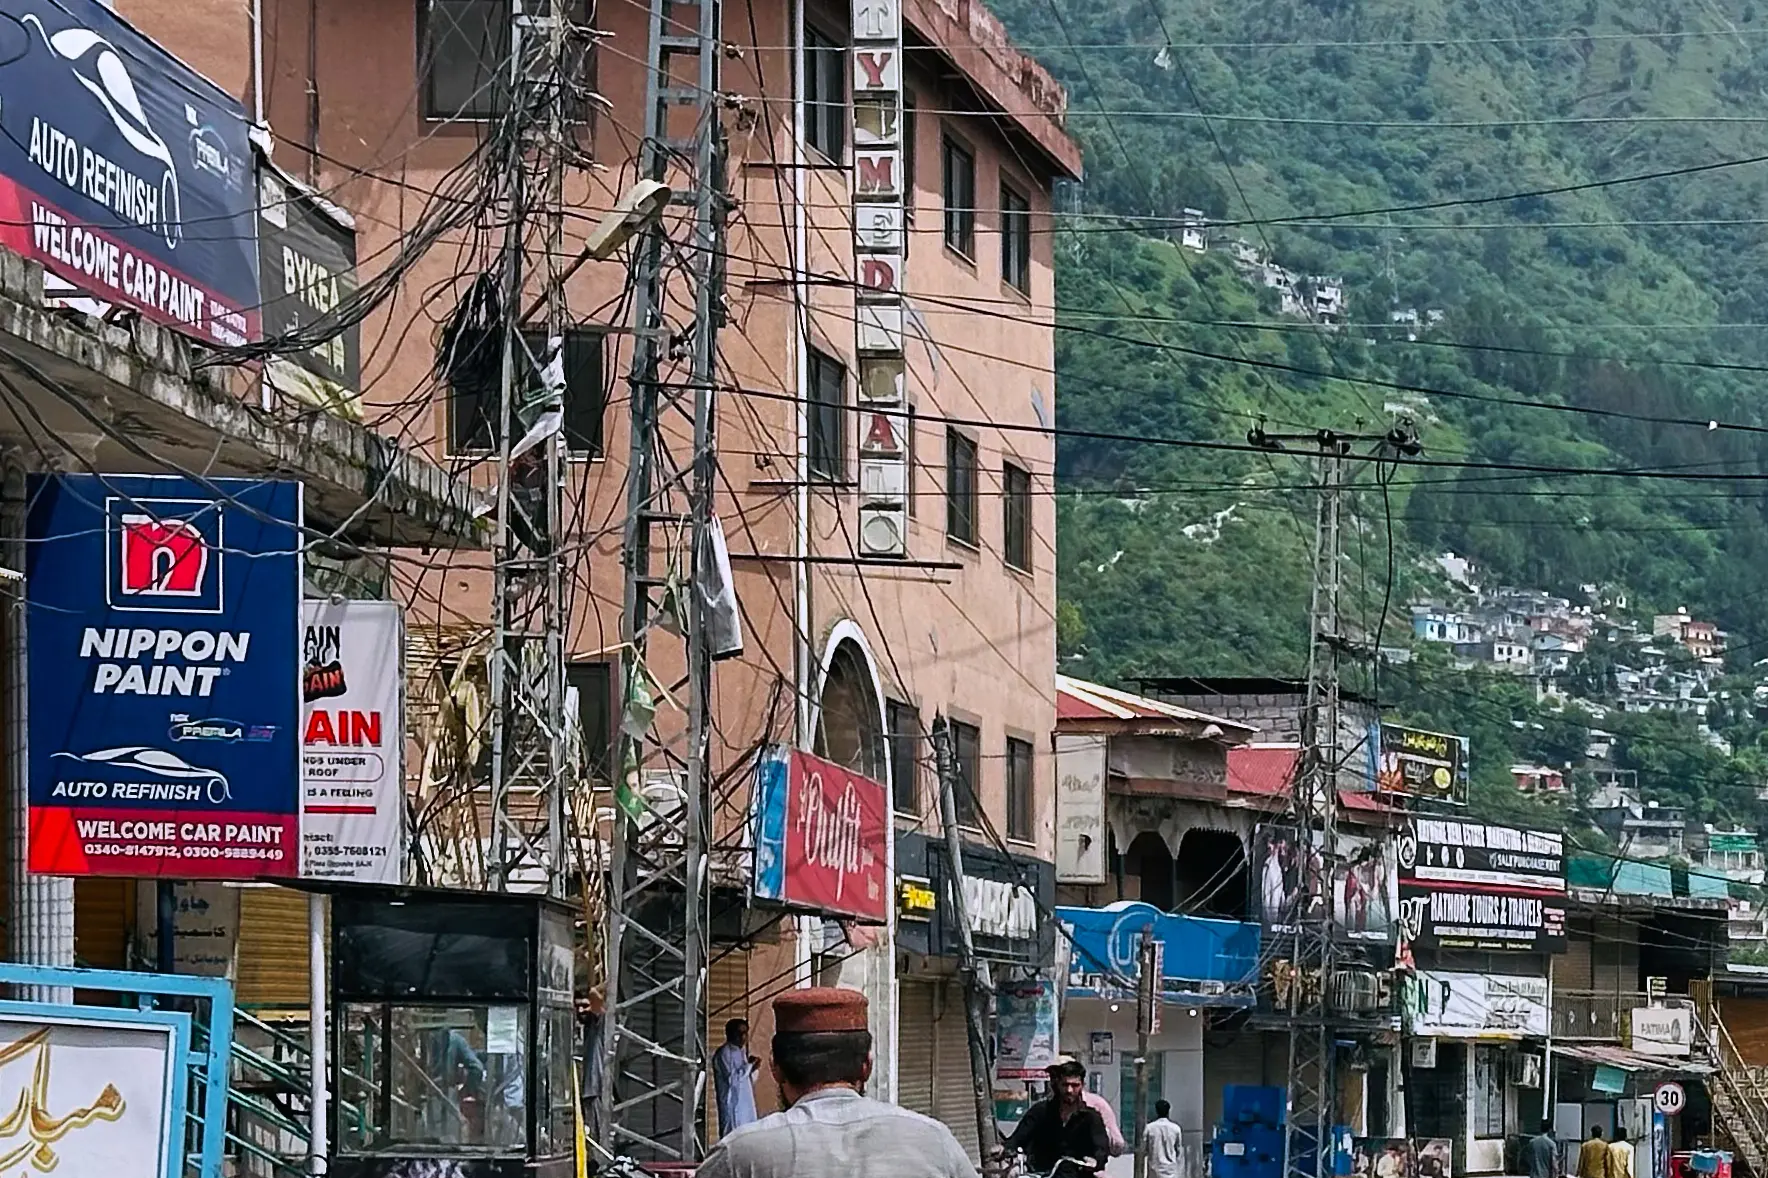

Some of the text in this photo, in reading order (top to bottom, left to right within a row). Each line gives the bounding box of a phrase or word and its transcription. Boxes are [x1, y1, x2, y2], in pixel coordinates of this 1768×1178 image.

[29, 116, 158, 232] AUTO REFINISH
[32, 202, 119, 286] WELCOME
[123, 252, 158, 304] CAR
[159, 273, 205, 329] PAINT
[80, 627, 250, 663] NIPPON
[93, 662, 222, 697] PAINT
[308, 768, 339, 777] ROOF
[328, 757, 366, 766] UNDER
[52, 781, 201, 801] AUTO REFINISH
[320, 788, 328, 797] A
[77, 820, 283, 844] WELCOME CAR PAINT
[1431, 892, 1470, 923] RATHORE
[1472, 895, 1499, 925] TOURS
[1500, 896, 1507, 925] &
[1508, 897, 1542, 927] TRAVELS
[1641, 1022, 1670, 1037] FATIMA
[1661, 1090, 1679, 1106] 30
